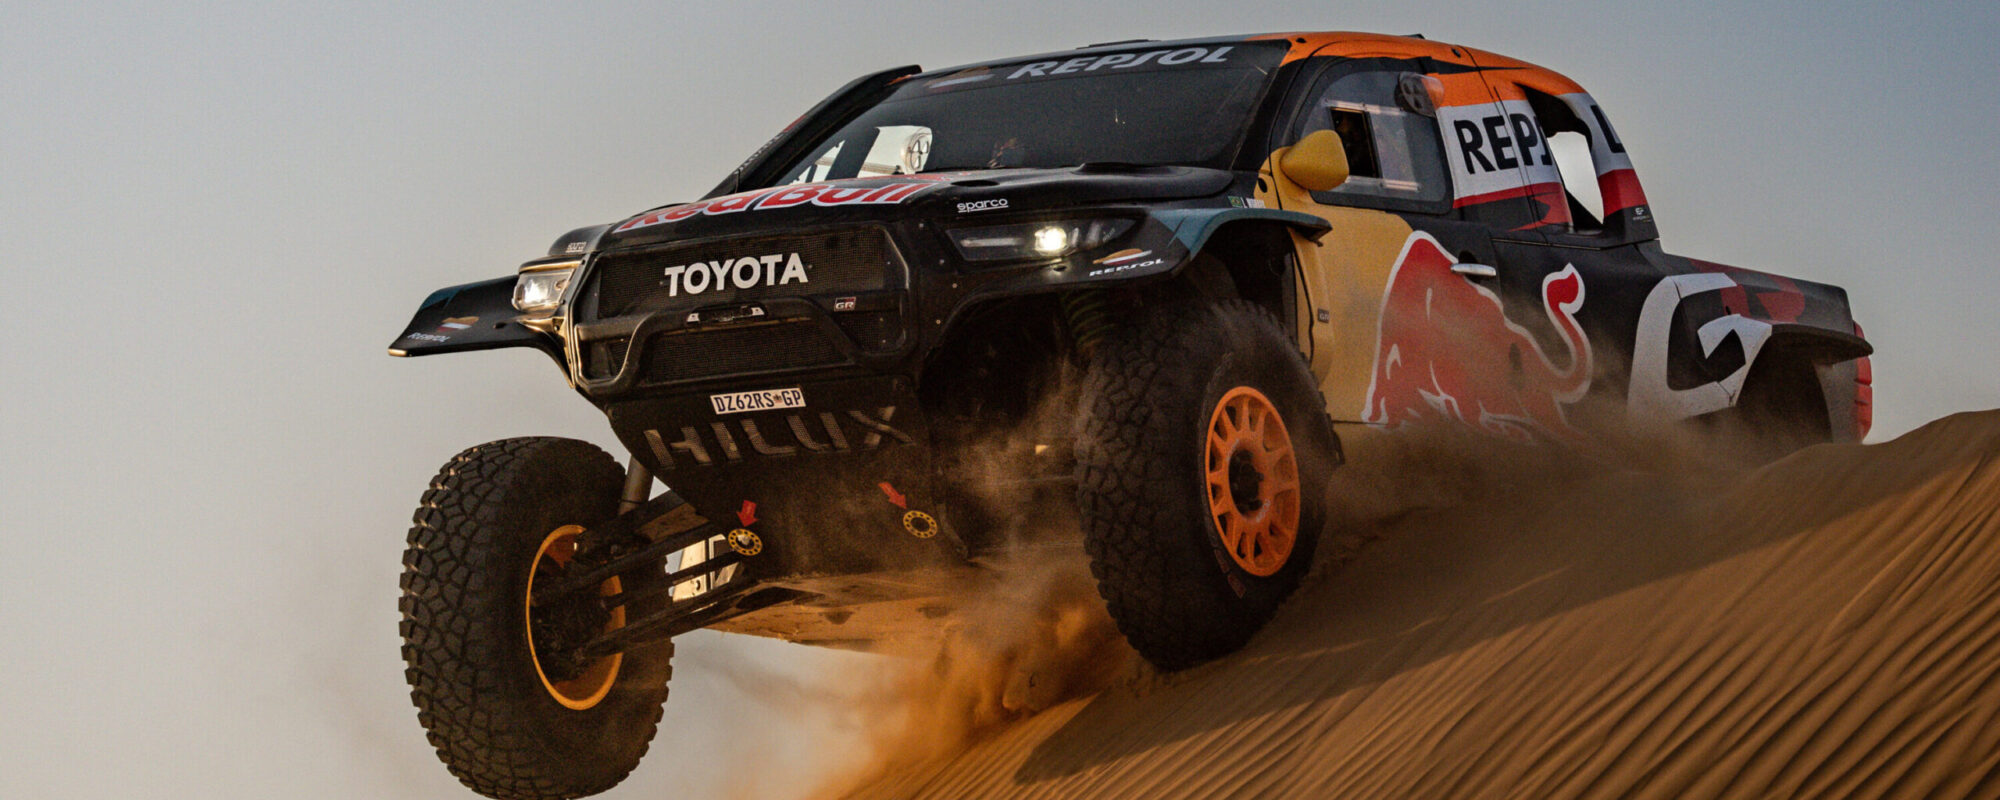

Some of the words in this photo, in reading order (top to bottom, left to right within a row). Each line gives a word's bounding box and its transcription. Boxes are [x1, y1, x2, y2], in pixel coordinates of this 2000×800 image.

[1007, 46, 1234, 79] REPSOL
[615, 187, 773, 233] Red
[753, 182, 939, 210] Bull
[957, 198, 1009, 213] sparco
[663, 252, 809, 297] TOYOTA
[1088, 258, 1165, 277] REPSOL
[714, 391, 775, 413] DZ62RS
[781, 389, 802, 407] GP
[642, 405, 916, 470] HILUX
